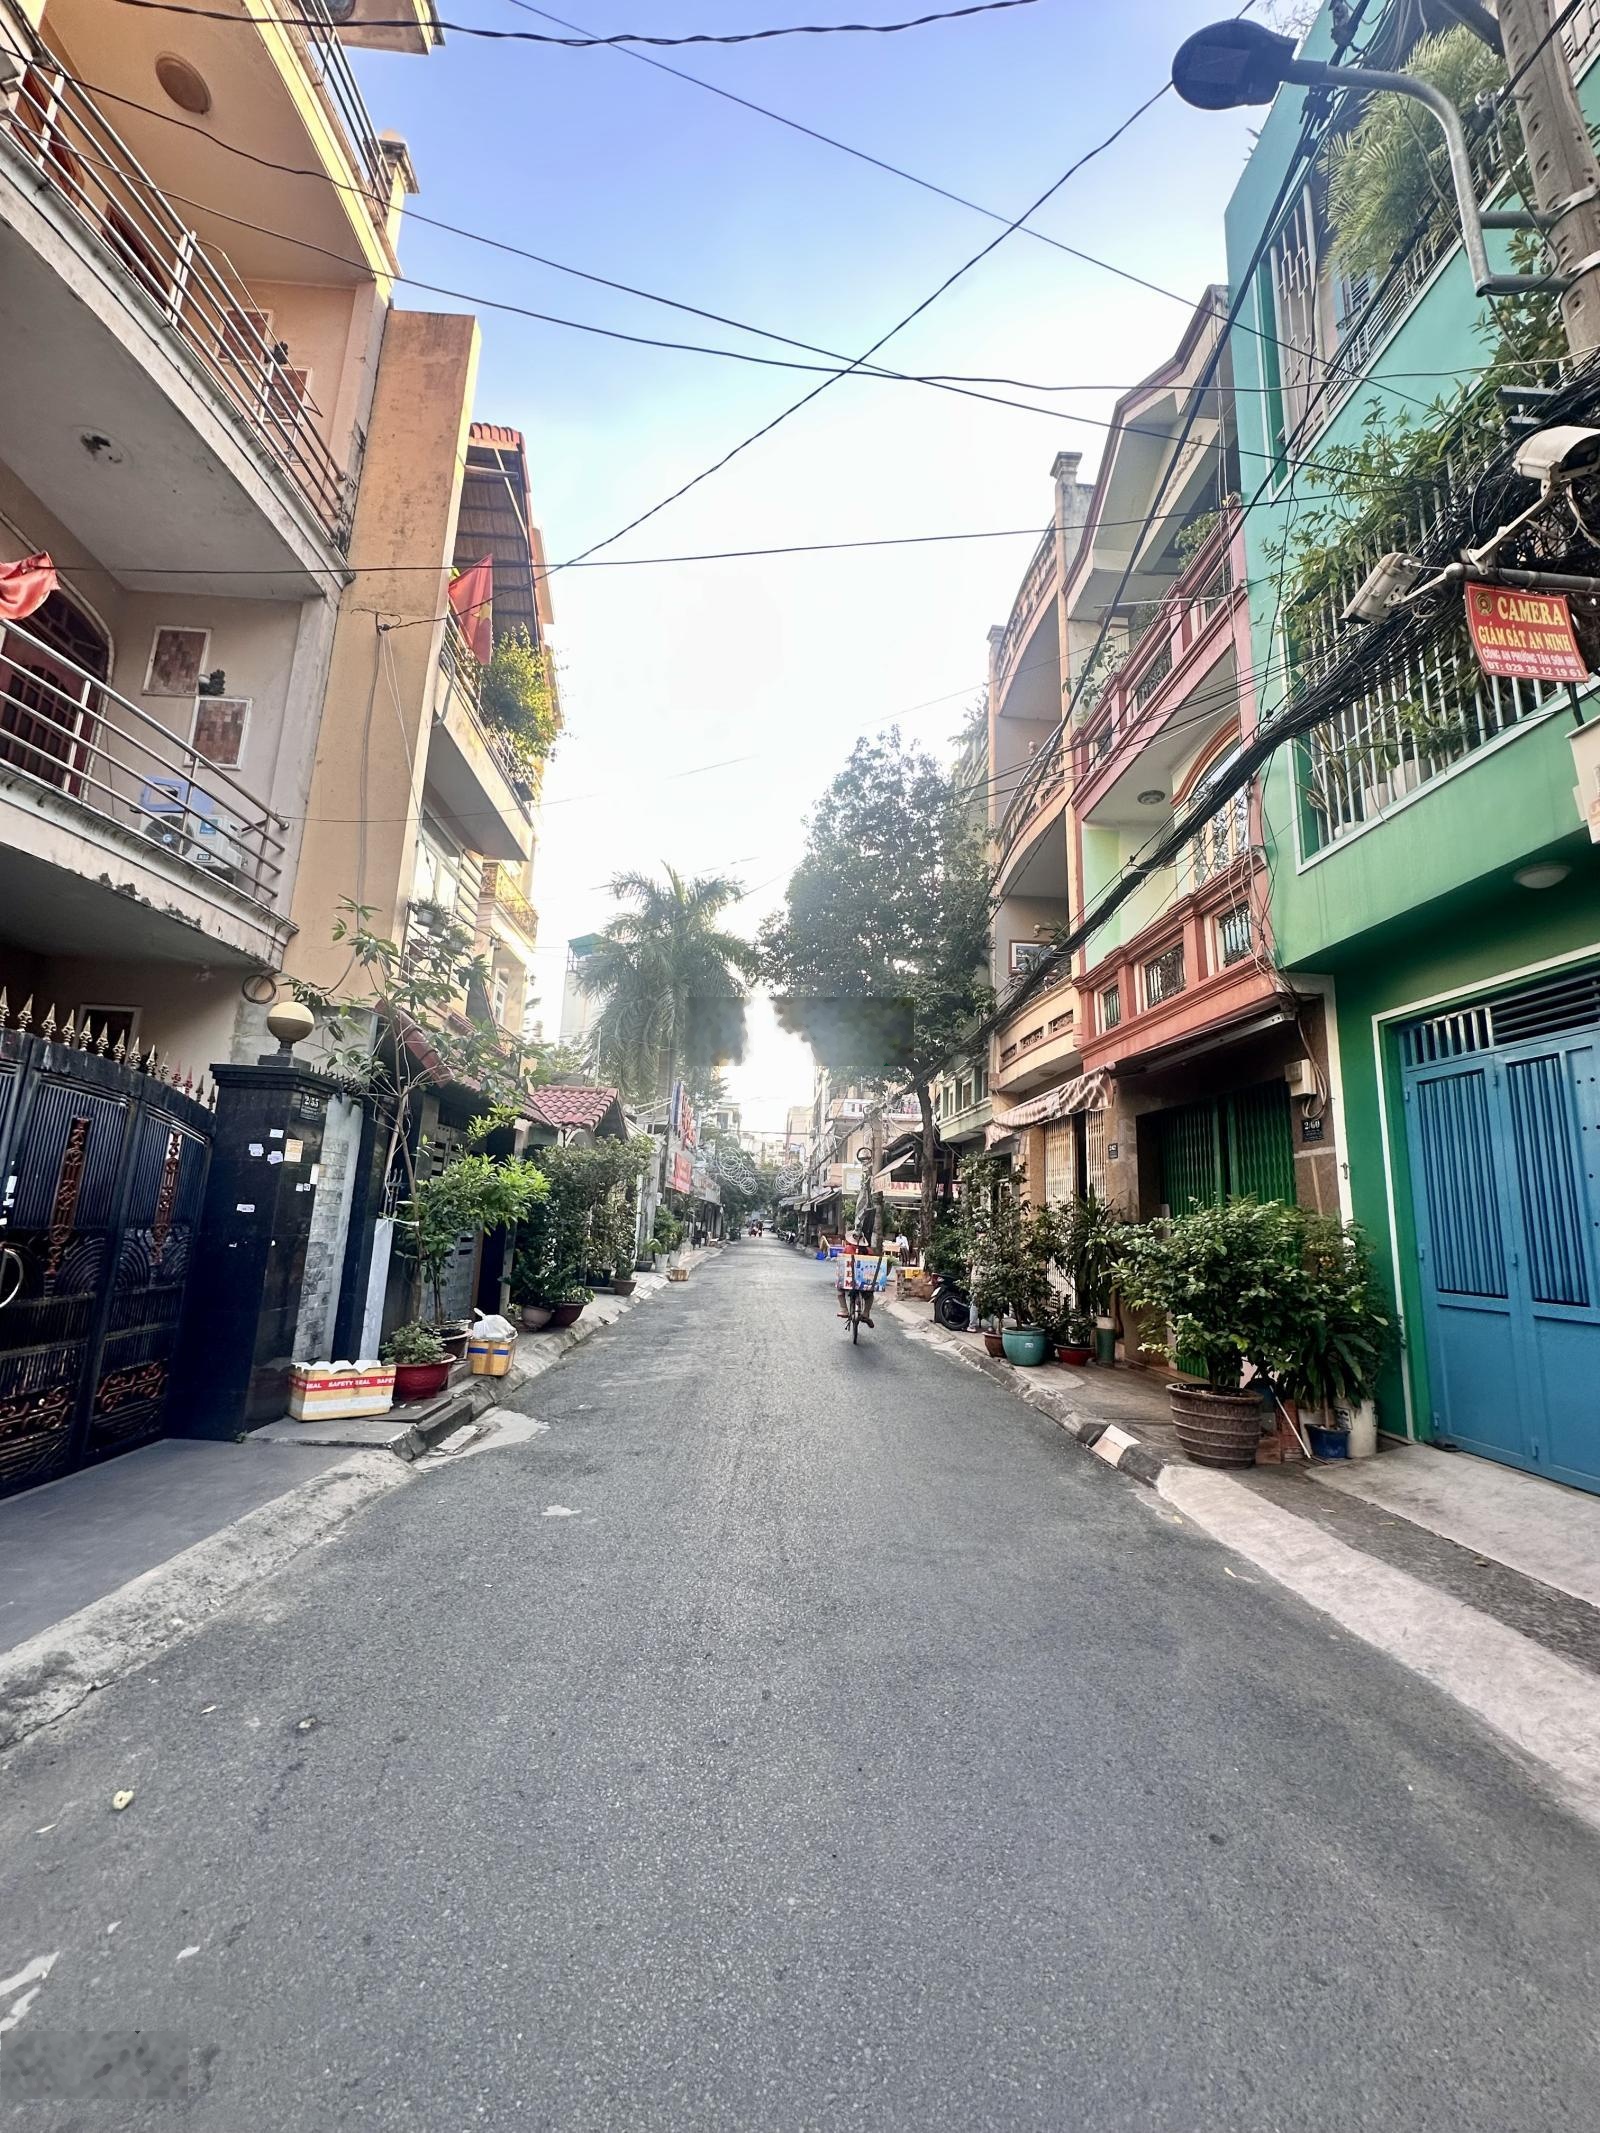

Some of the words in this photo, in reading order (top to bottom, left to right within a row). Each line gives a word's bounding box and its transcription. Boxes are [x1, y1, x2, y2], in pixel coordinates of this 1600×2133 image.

[1497, 596, 1566, 626] CAMERA
[1478, 620, 1507, 646] GIÁM
[1505, 623, 1527, 648] SÁT
[1528, 631, 1545, 650] AN
[1542, 632, 1573, 652] NINH
[1505, 662, 1525, 673] 028
[1525, 664, 1540, 674] 38
[1540, 666, 1553, 676] 12
[1554, 667, 1568, 677] 19
[1569, 668, 1583, 677] 61
[328, 1380, 354, 1388] SAFETY
